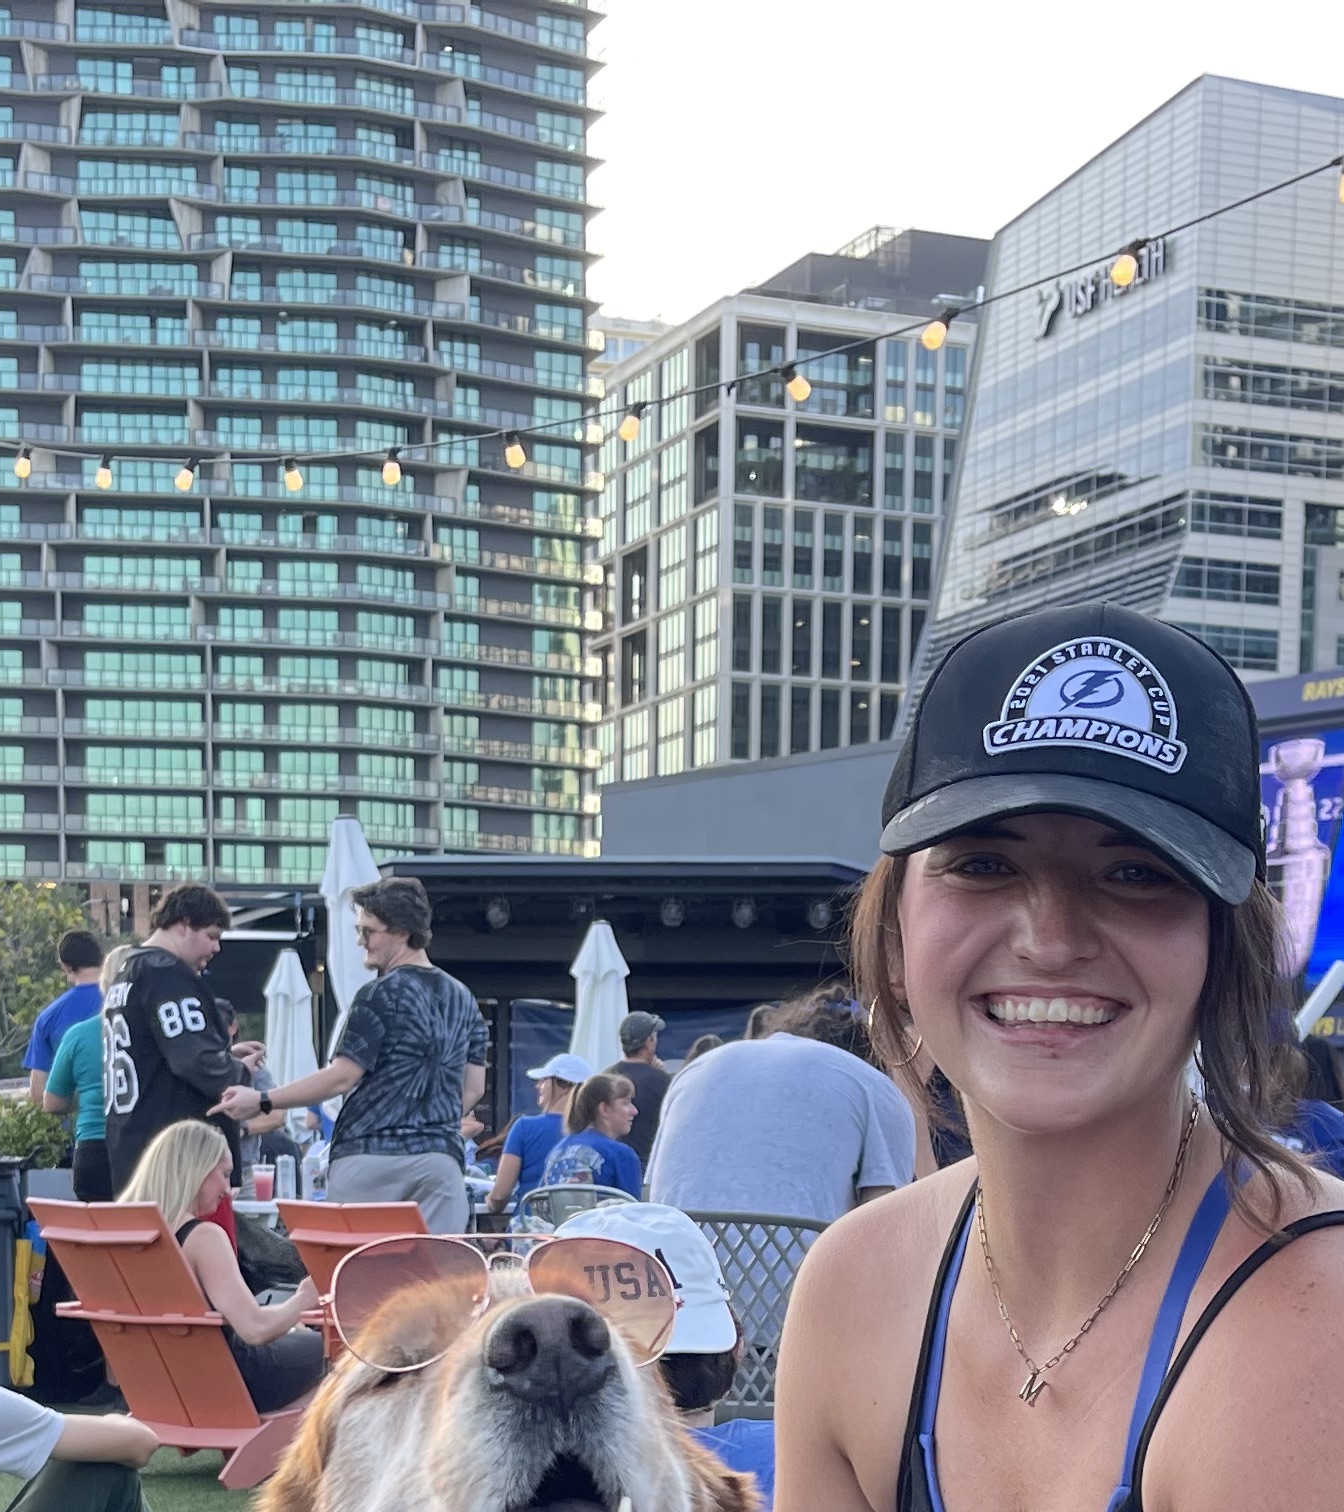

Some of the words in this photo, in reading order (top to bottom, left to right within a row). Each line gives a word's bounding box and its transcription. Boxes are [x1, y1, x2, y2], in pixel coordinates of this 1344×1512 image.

[1063, 277, 1096, 319] USF
[1098, 238, 1164, 302] HLTH
[1010, 664, 1048, 710] 2021
[1051, 642, 1152, 679] STANLEY
[1148, 686, 1170, 727] CUP
[992, 718, 1178, 763] CHAMPIONS
[157, 997, 206, 1039] 86
[1310, 1016, 1335, 1036] YS
[583, 1250, 674, 1303] USA
